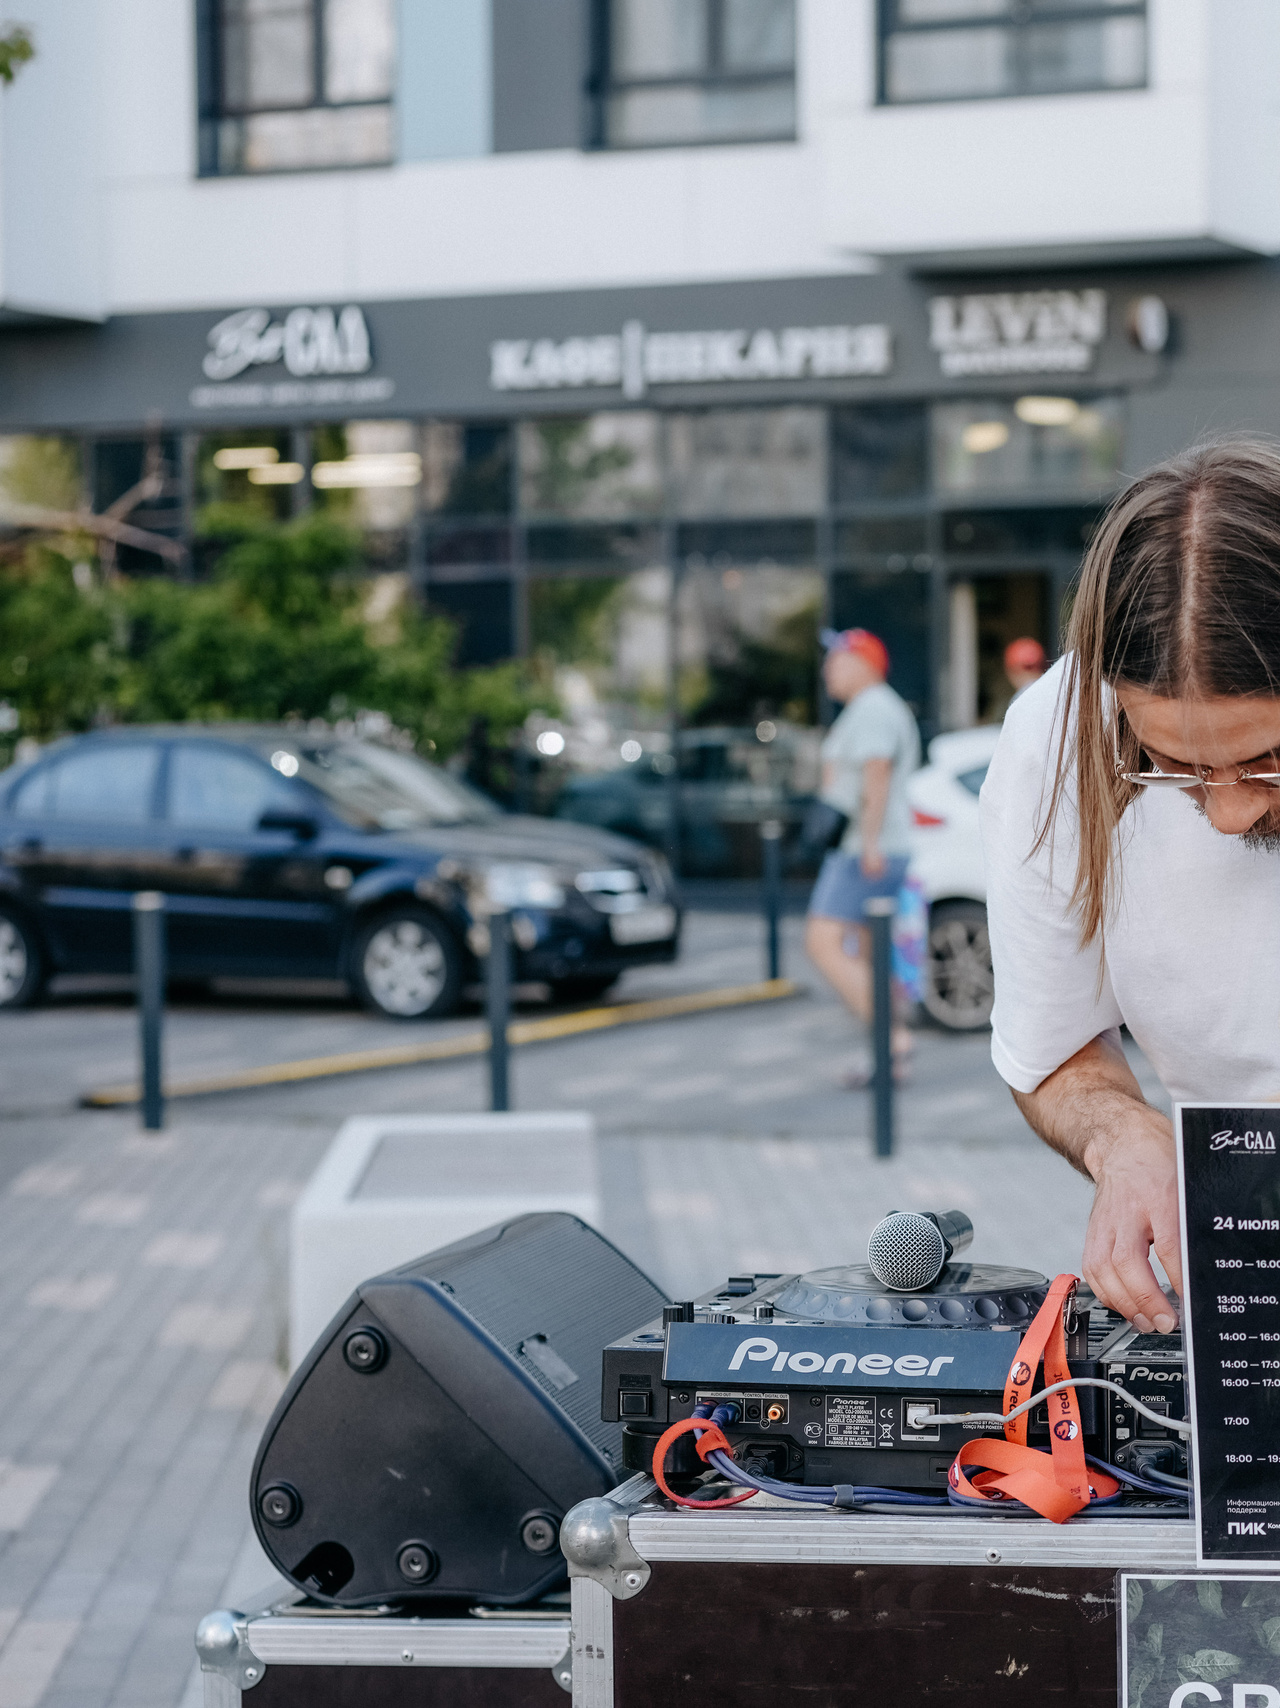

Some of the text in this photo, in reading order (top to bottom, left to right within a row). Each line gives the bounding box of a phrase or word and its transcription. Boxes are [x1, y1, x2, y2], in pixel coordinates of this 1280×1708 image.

[1214, 1217, 1279, 1230] 24 июля
[1215, 1260, 1242, 1268] 13:00
[1217, 1296, 1278, 1304] 13:00, 14:00,
[1218, 1305, 1244, 1313] 15:00
[728, 1337, 955, 1376] Pioneer
[1221, 1360, 1248, 1368] 14:00
[1228, 1522, 1267, 1535] ПИК
